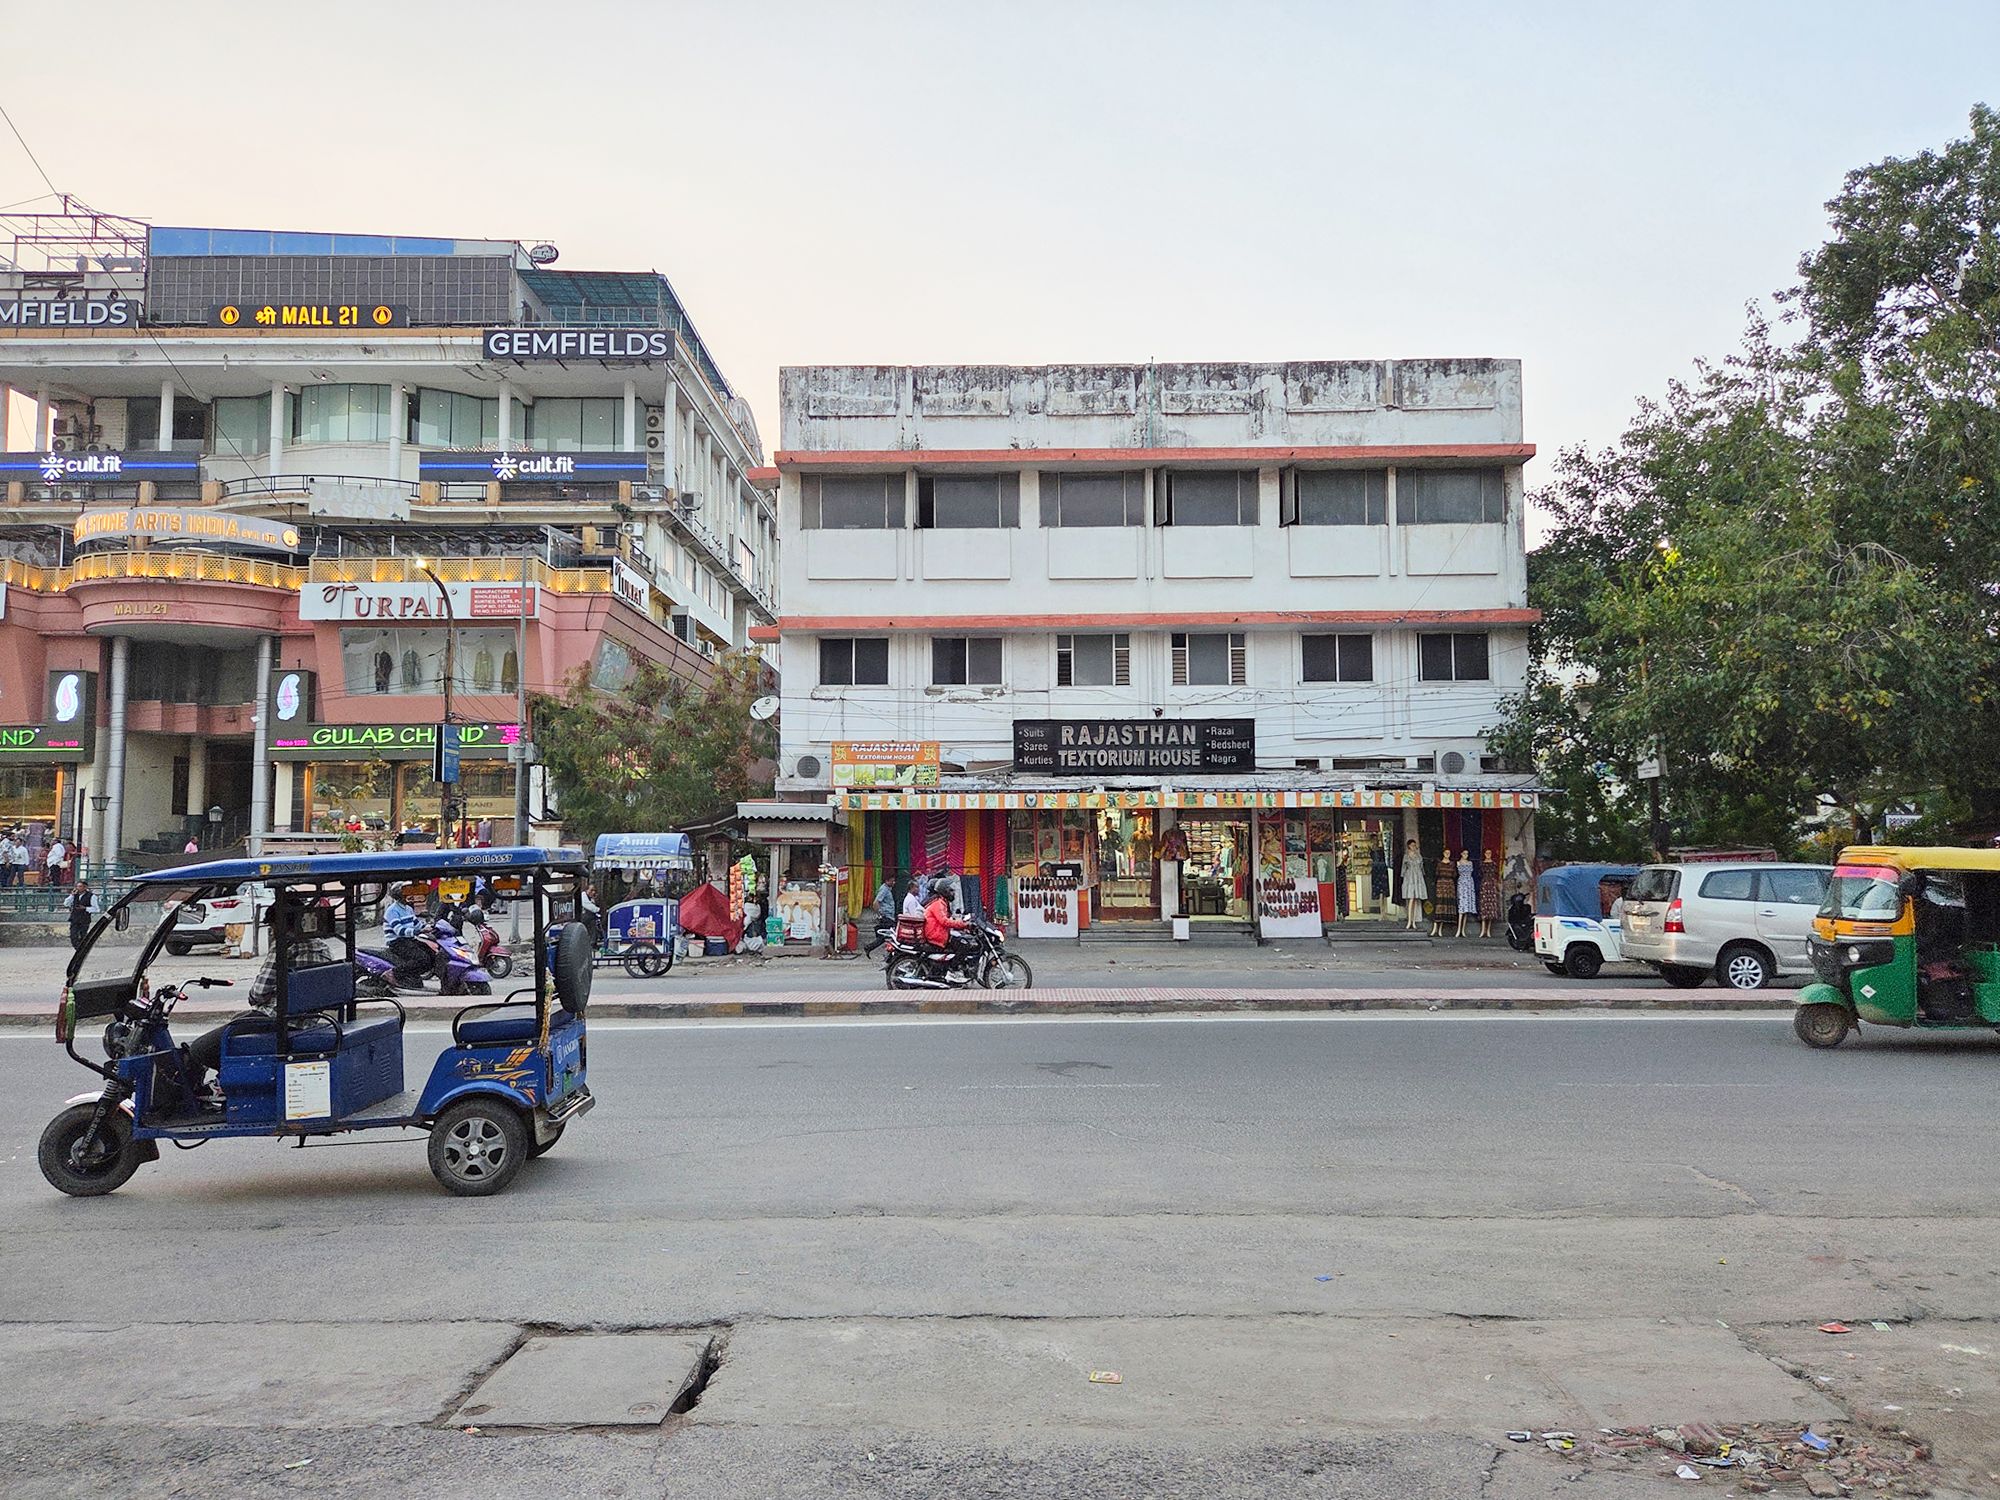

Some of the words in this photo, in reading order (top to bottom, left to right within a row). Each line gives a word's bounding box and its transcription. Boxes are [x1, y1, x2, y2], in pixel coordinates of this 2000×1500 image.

[255, 306, 277, 325] श्री
[282, 306, 334, 325] MALL
[338, 306, 358, 325] 21
[488, 332, 667, 356] GEMFIELDS
[66, 455, 122, 473] cult.fit
[518, 456, 574, 473] cult.fit
[134, 512, 182, 532] ARTS
[186, 514, 238, 537] INDIA
[0, 729, 36, 746] ND
[312, 727, 395, 744] GULAB
[400, 726, 484, 744] CHND
[1023, 728, 1044, 738] Suits
[1061, 725, 1196, 746] RAJASTHAN
[1210, 726, 1234, 736] Razai
[850, 743, 920, 752] RAJASTHAN
[1023, 741, 1048, 751] Saree
[1210, 740, 1250, 749] Bedsheet
[1024, 755, 1054, 765] Kurties
[1058, 749, 1145, 766] TEXTORIUM
[1149, 749, 1200, 766] HOUSE
[1210, 754, 1237, 764] Nagra
[617, 836, 660, 846] Amul
